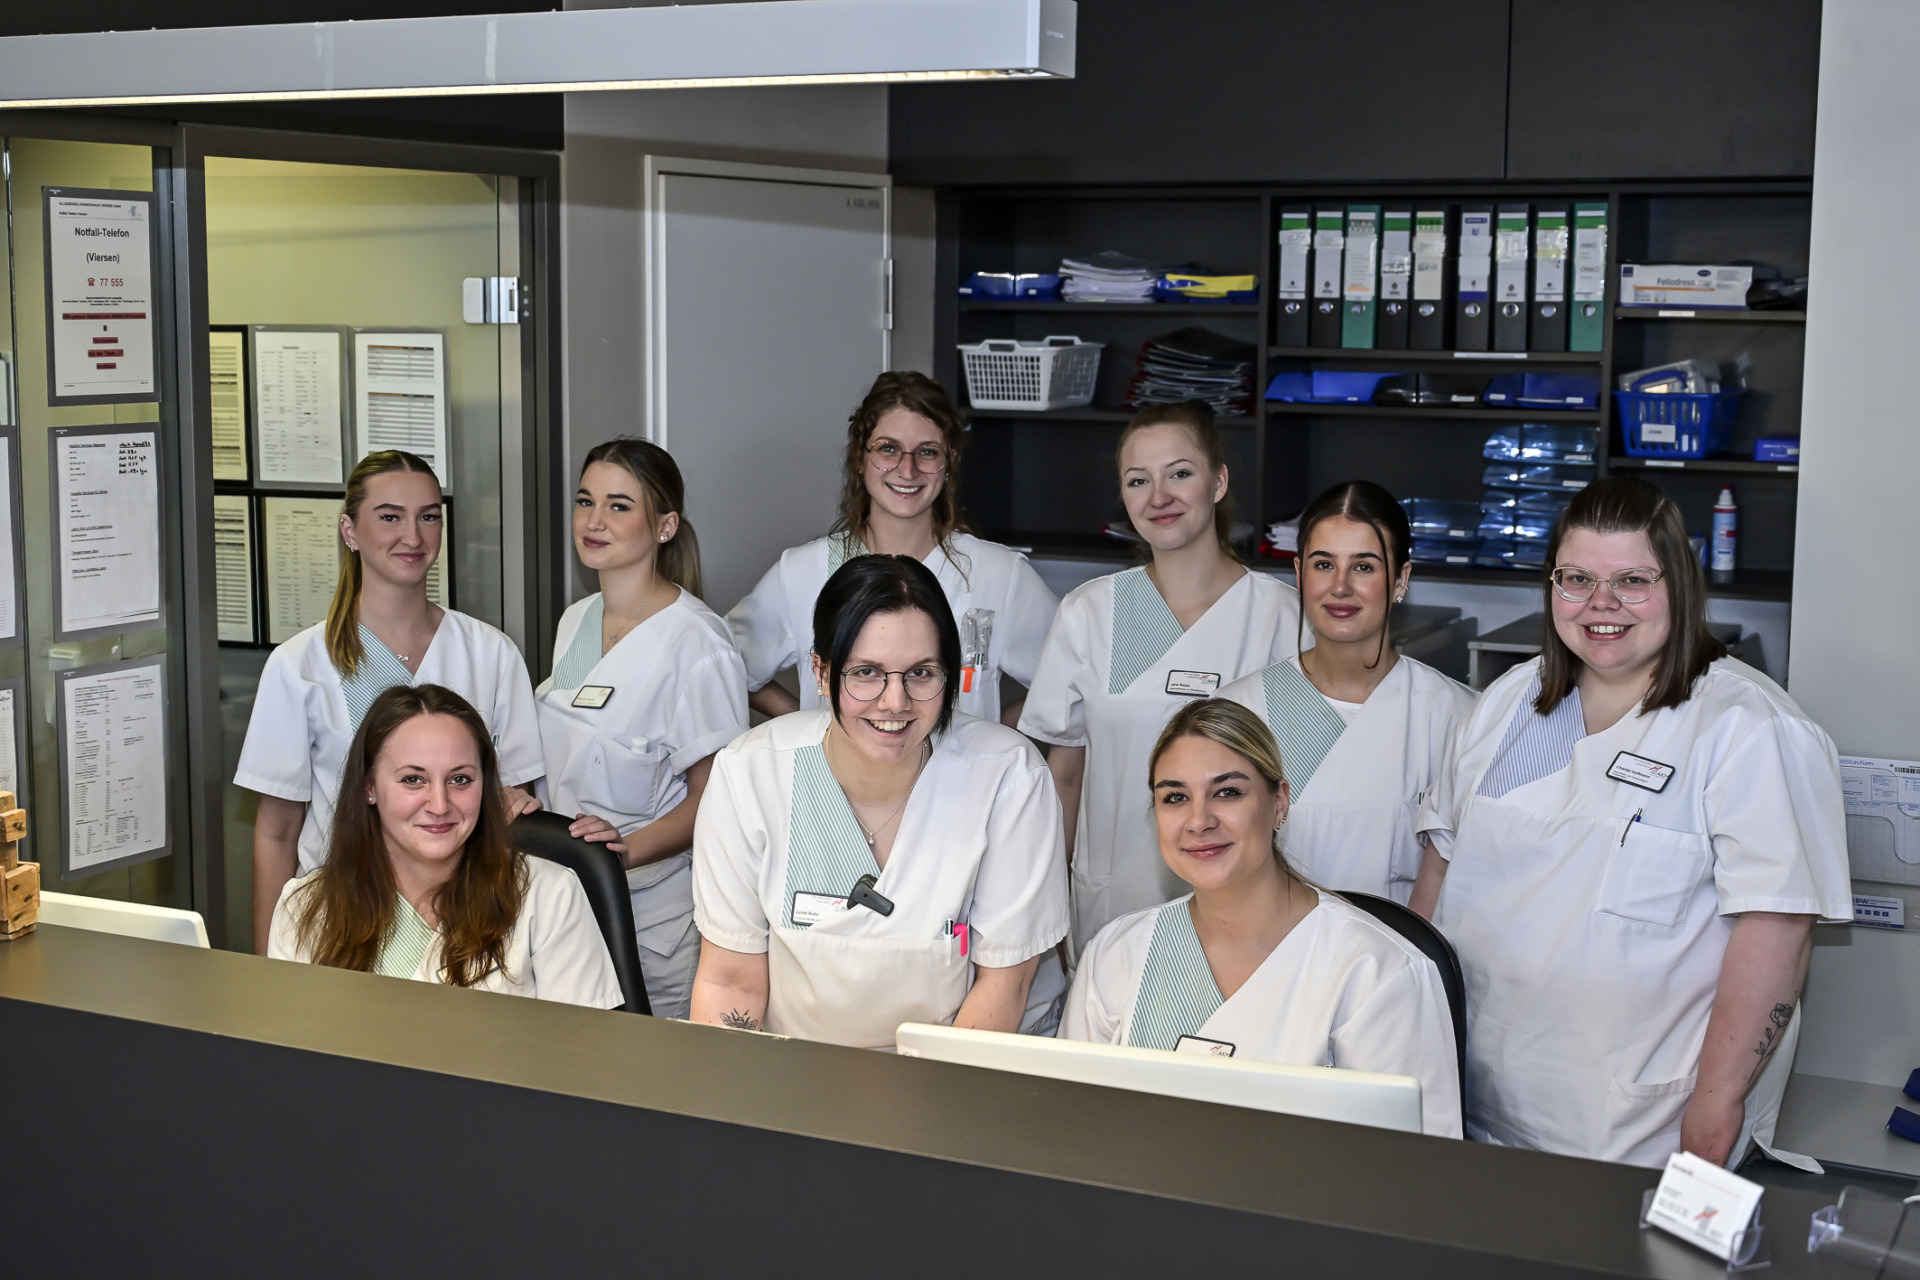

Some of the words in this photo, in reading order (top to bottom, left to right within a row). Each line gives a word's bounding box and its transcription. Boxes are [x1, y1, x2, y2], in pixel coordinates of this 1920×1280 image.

[75, 227, 129, 238] Notfall-Telefon
[86, 252, 120, 264] (Viersen)
[99, 278, 108, 287] 77
[110, 278, 124, 287] 555
[1657, 277, 1695, 286] Foliodress
